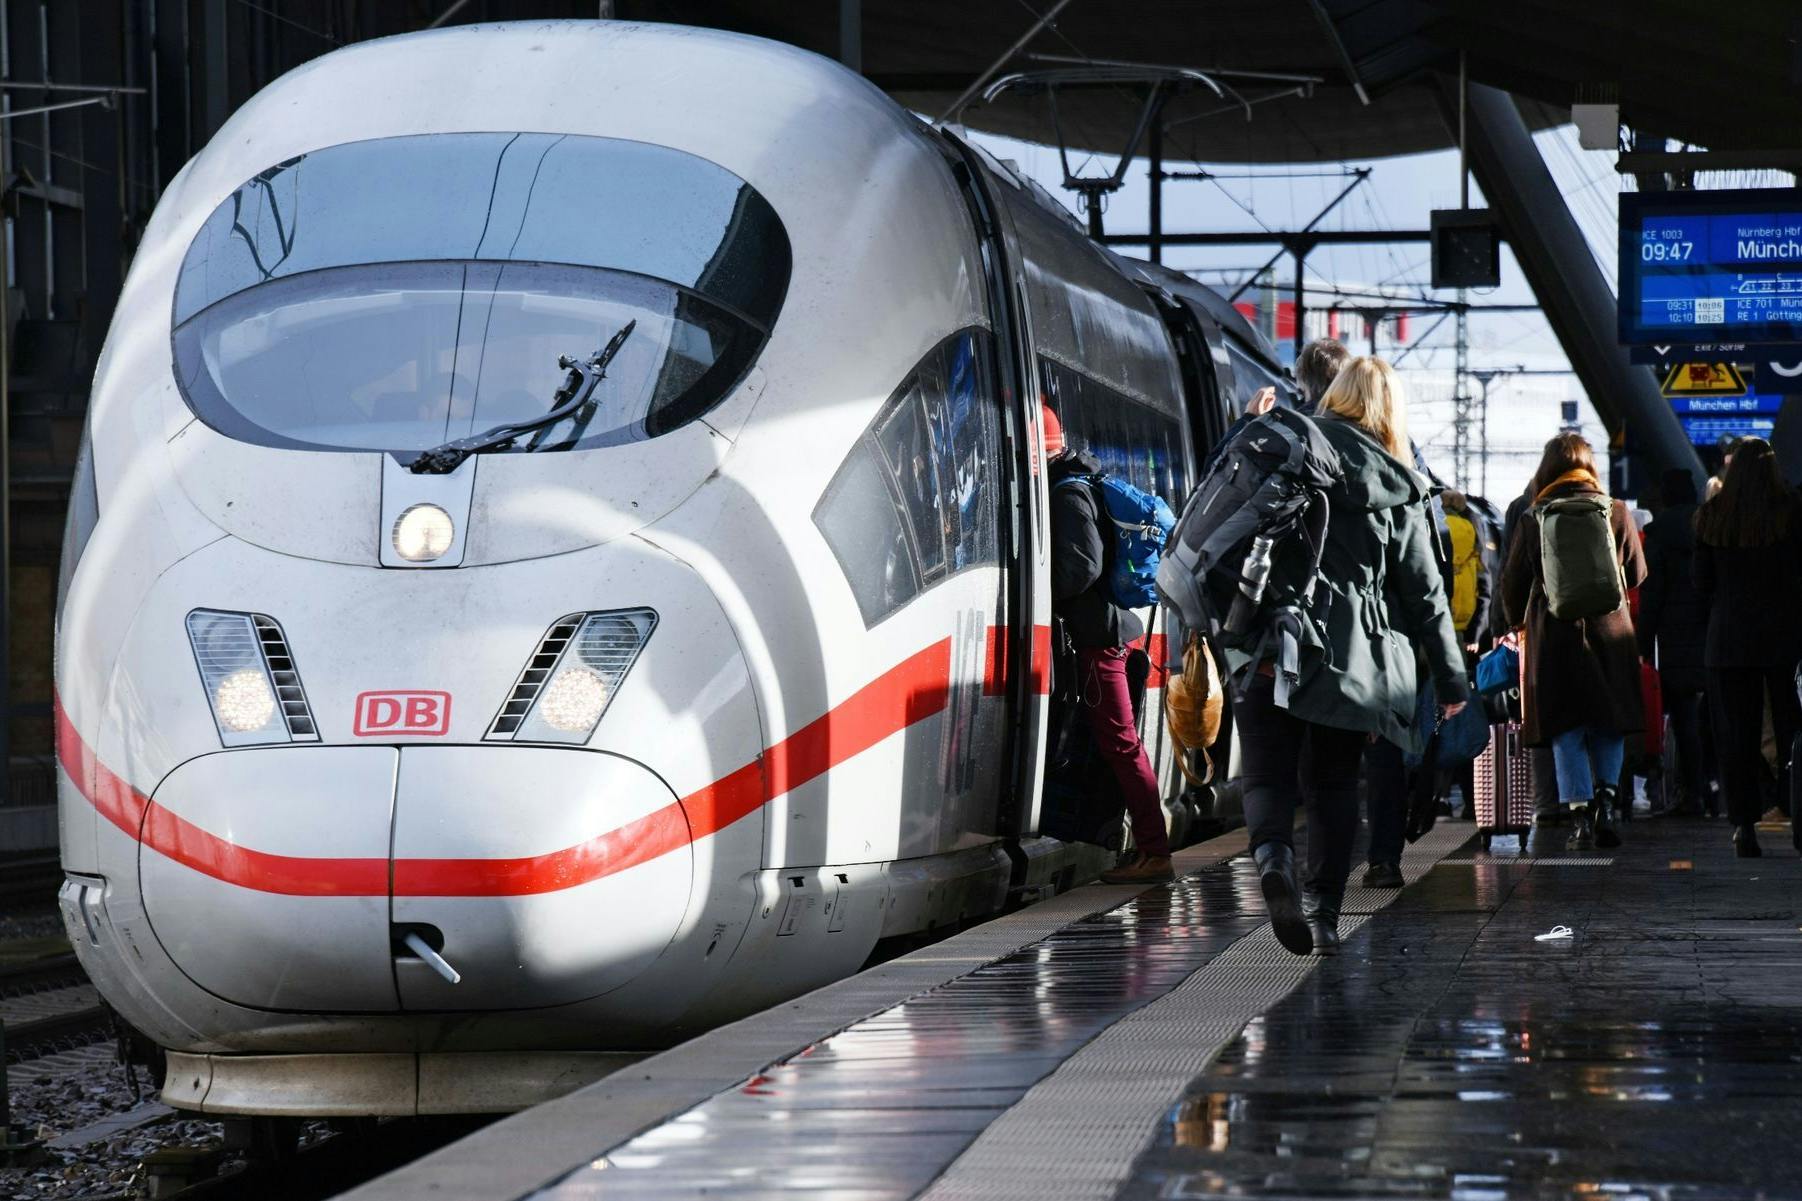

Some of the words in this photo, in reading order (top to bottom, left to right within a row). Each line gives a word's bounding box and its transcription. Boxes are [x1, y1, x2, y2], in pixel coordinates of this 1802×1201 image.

[1662, 230, 1682, 239] 1003
[1738, 228, 1781, 238] Nürnberg
[1785, 227, 1800, 236] Hbf
[1642, 242, 1693, 261] 09:47
[1737, 239, 1802, 259] Münch
[1667, 301, 1693, 311] 09:31
[1737, 299, 1752, 309] ICE
[1754, 299, 1773, 309] 701
[1669, 312, 1693, 322] 10:10
[1737, 311, 1750, 321] RE
[1689, 400, 1736, 410] München
[1740, 400, 1758, 410] Hbf
[366, 697, 440, 729] DB
